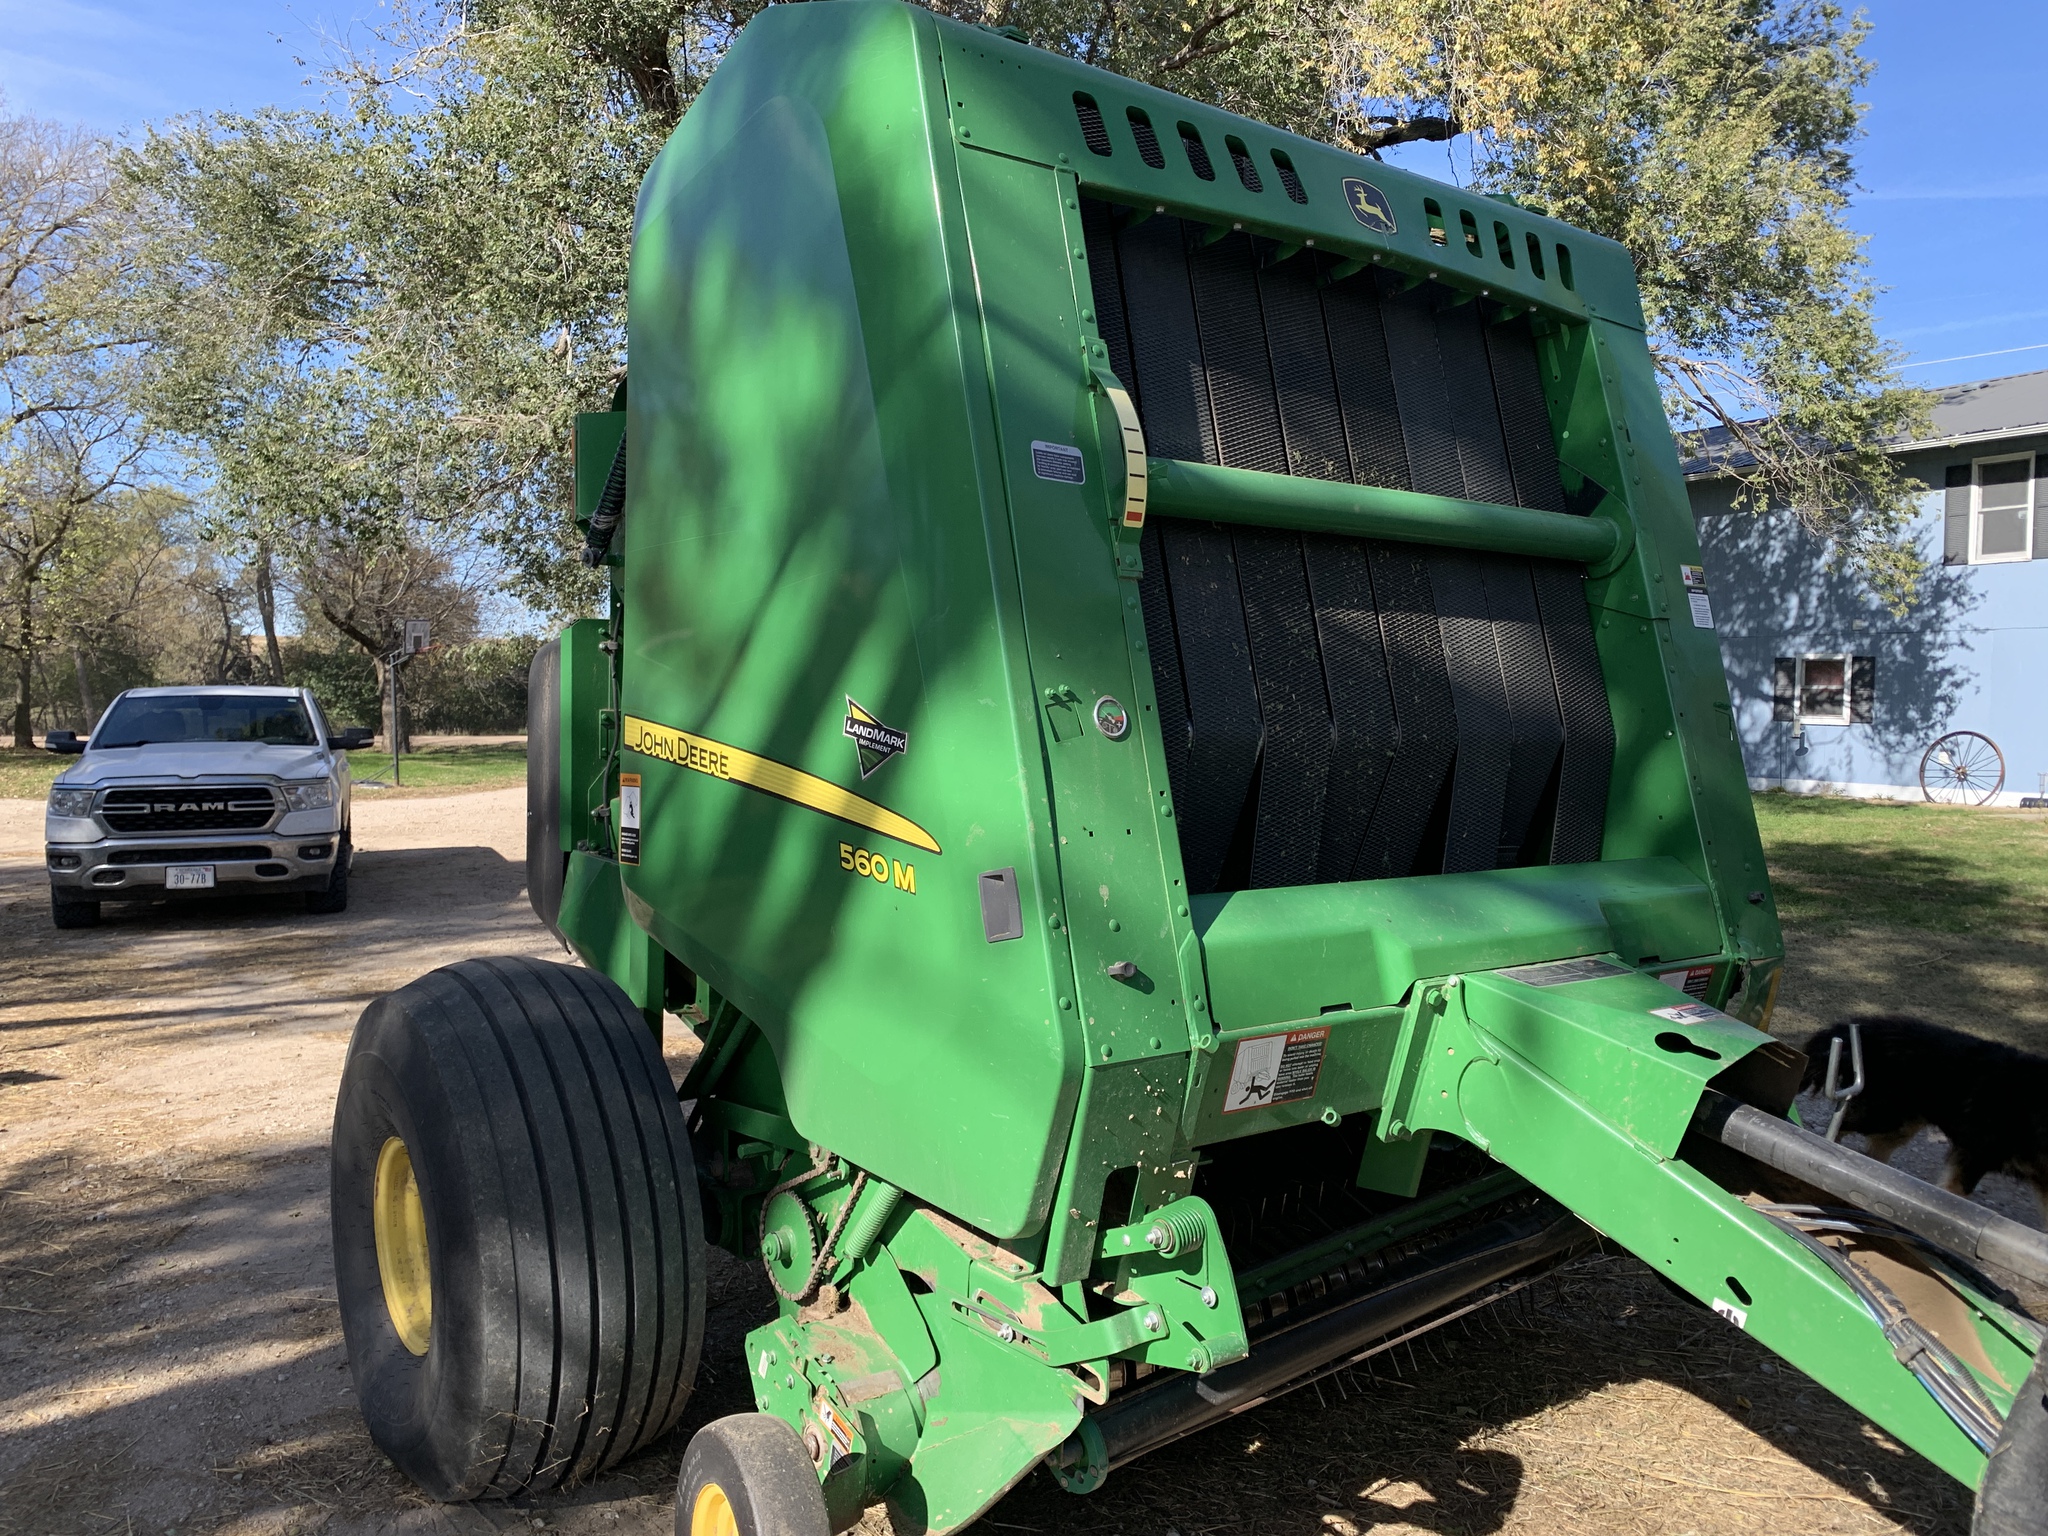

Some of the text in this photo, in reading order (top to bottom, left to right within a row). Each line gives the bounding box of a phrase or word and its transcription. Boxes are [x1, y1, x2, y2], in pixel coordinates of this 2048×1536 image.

[635, 726, 729, 776] JOHN DEERE
[858, 738, 891, 753] IMPLEMENT
[153, 802, 225, 812] RAM
[839, 841, 917, 896] 560 M
[1297, 1030, 1326, 1043] DANGER
